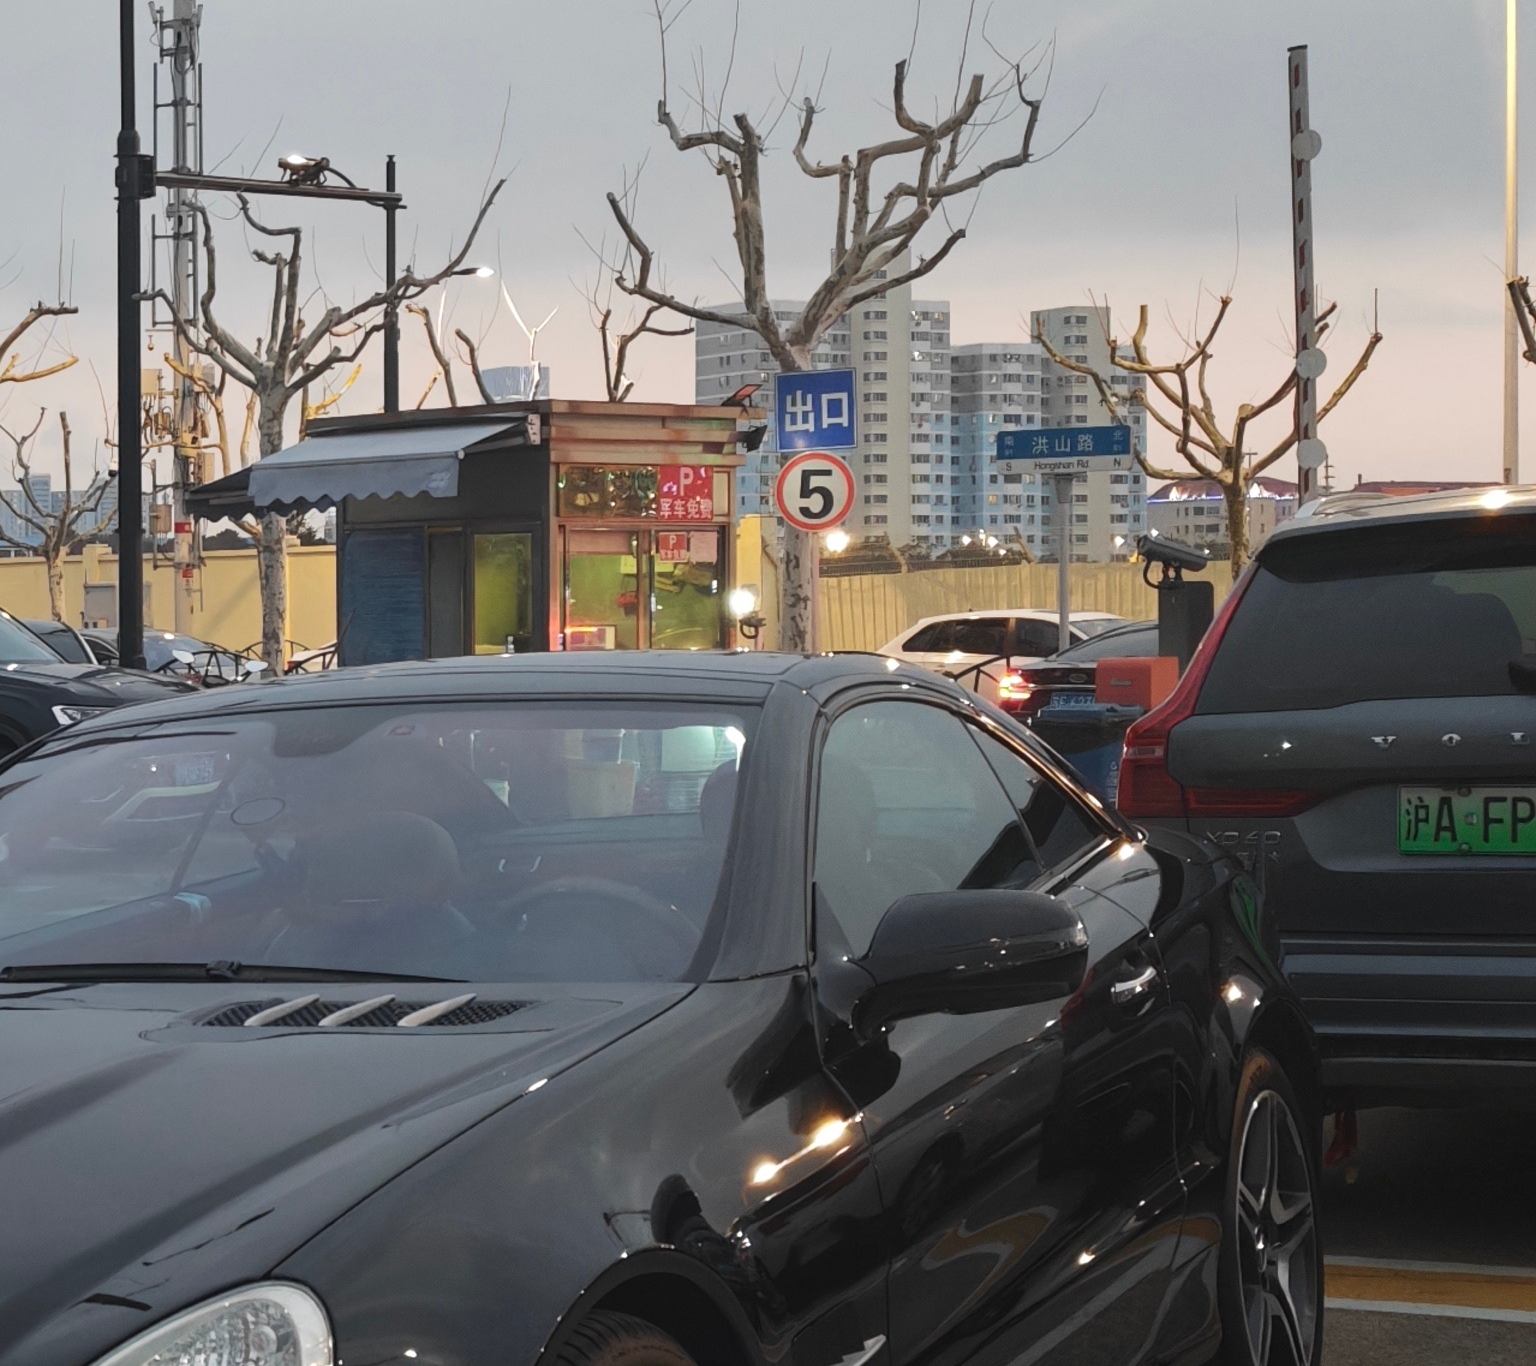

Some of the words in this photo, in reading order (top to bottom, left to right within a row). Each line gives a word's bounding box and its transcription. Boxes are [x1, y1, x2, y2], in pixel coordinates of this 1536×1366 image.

[785, 390, 849, 433] 出口
[1032, 434, 1094, 455] 洪山路
[1005, 462, 1012, 471] S
[1034, 460, 1075, 471] Hongshan
[1113, 458, 1121, 467] N
[679, 466, 694, 497] P
[798, 469, 834, 520] 5
[659, 498, 713, 519] 军车免费
[669, 535, 677, 550] P
